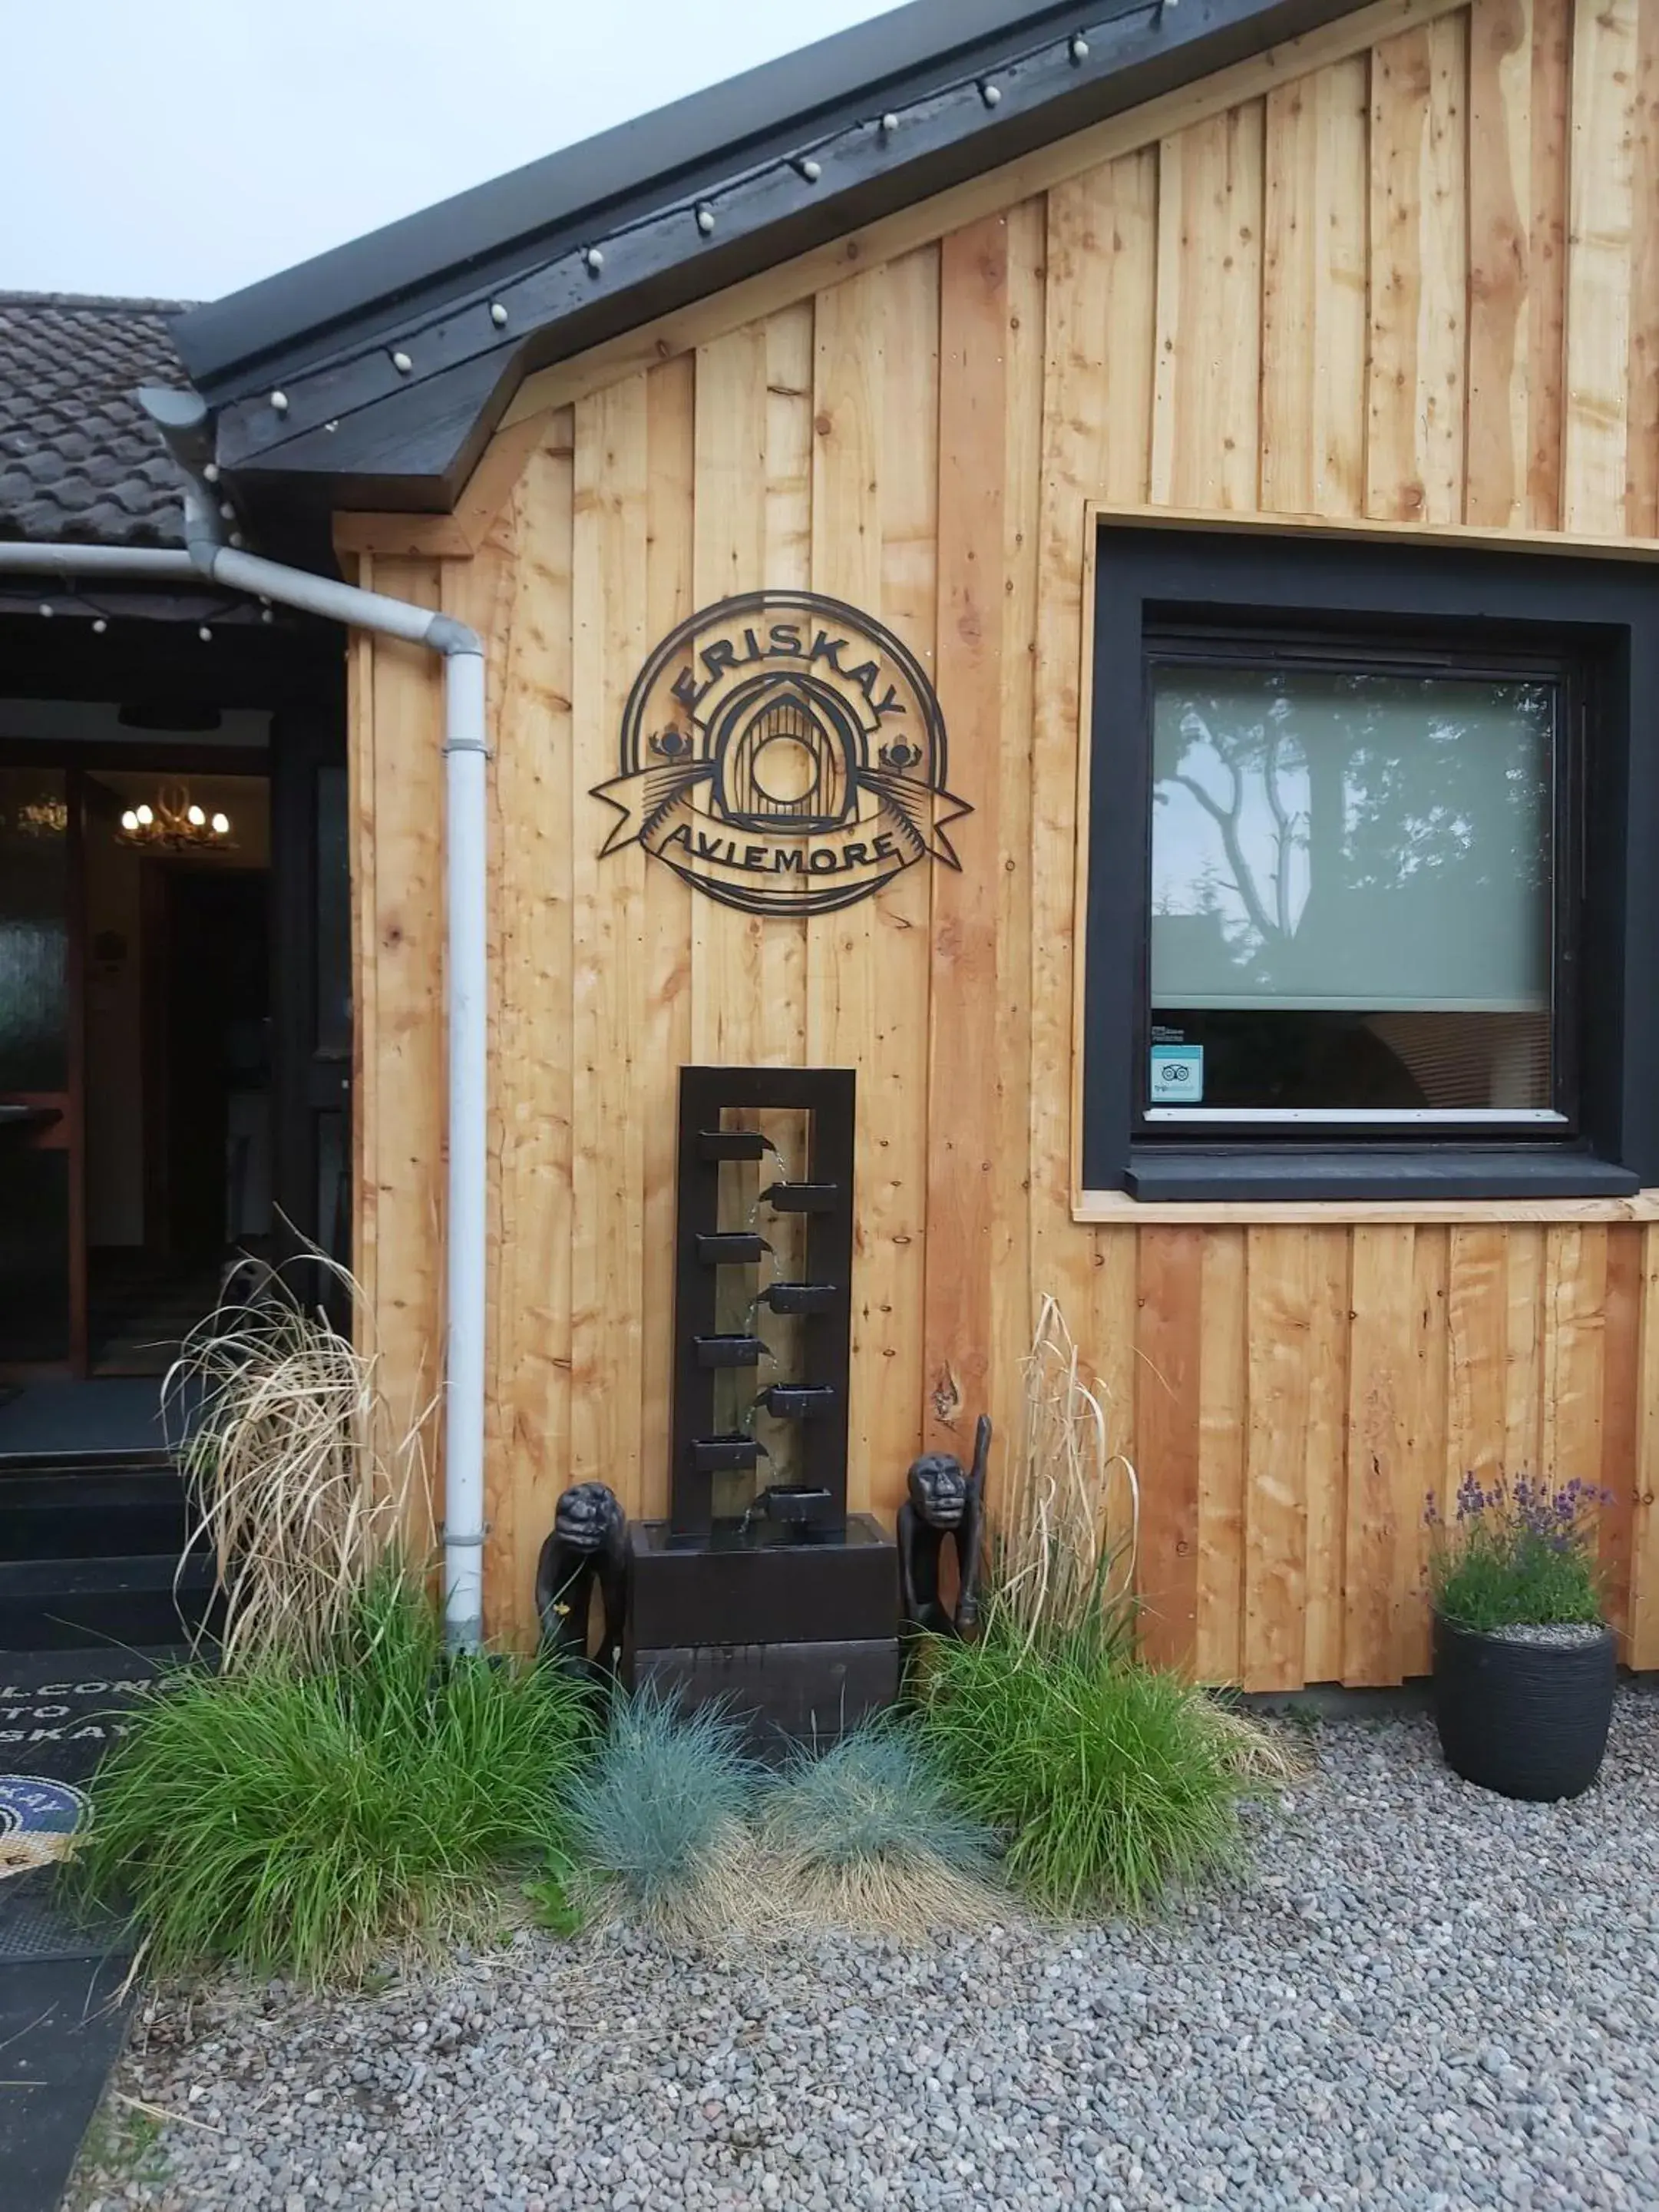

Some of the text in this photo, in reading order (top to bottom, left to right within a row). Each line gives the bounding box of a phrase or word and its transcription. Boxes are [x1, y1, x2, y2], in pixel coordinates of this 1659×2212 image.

[670, 624, 907, 715] ERISKAY
[666, 823, 897, 874] AVIEMORE
[0, 1678, 187, 1698] LCOME
[1, 1704, 71, 1721] TO
